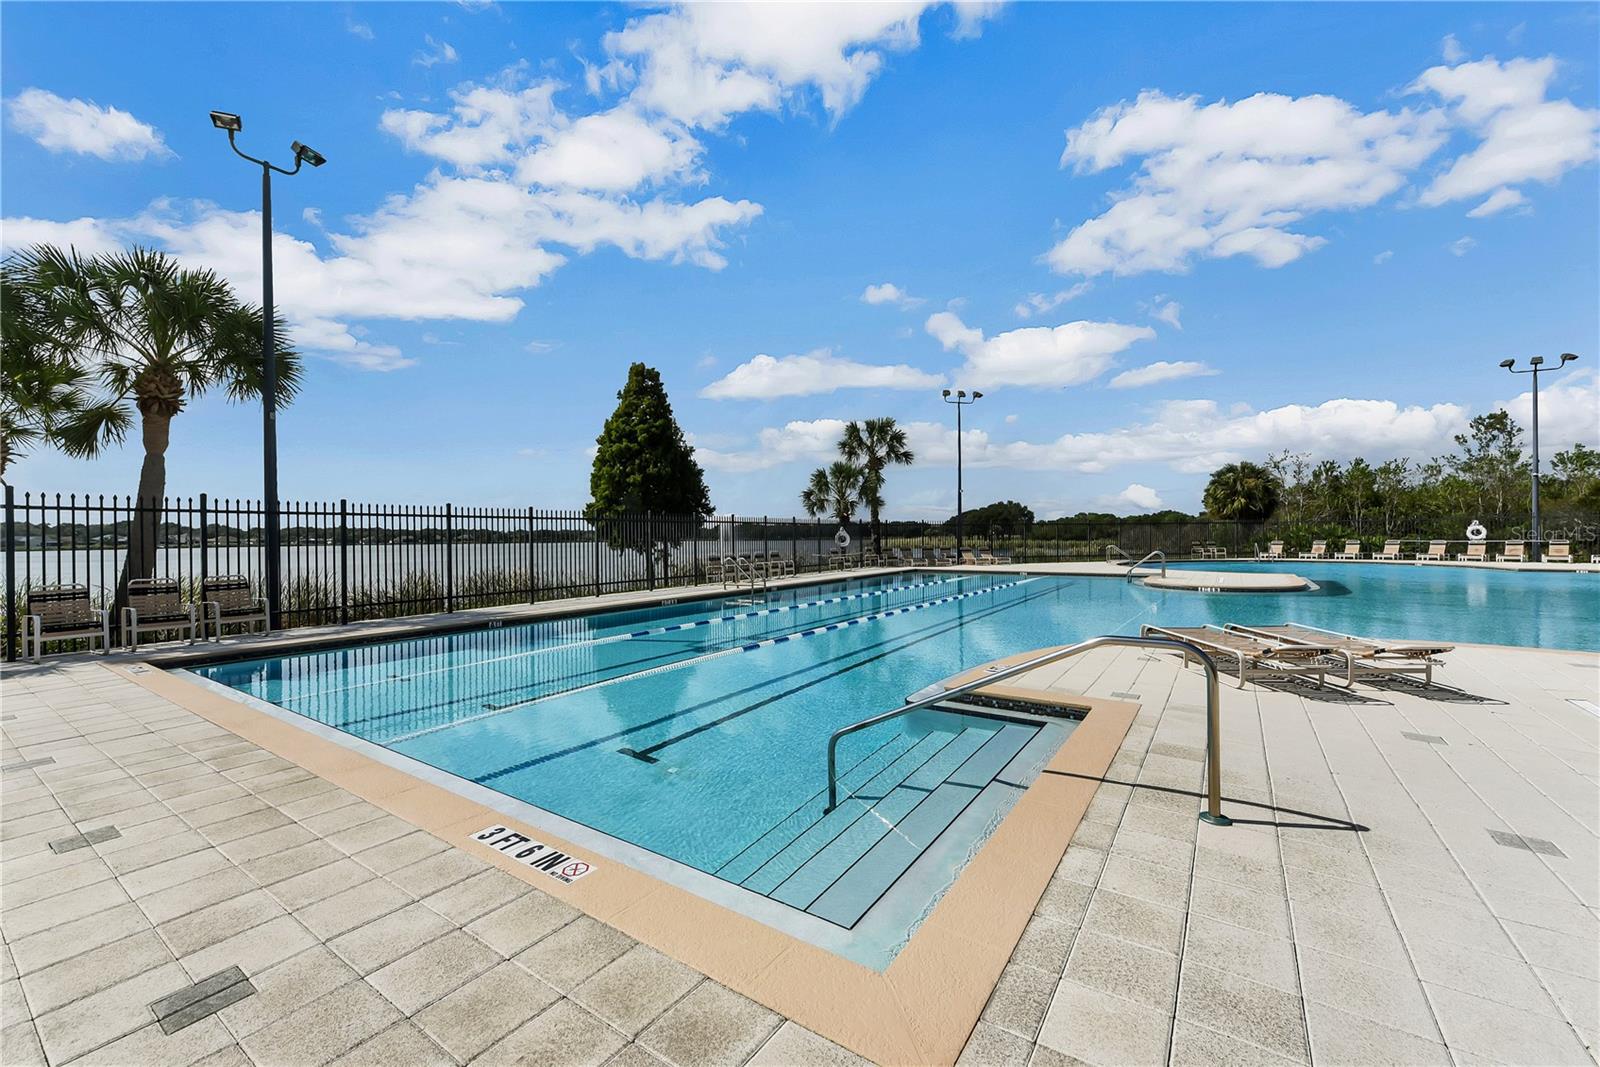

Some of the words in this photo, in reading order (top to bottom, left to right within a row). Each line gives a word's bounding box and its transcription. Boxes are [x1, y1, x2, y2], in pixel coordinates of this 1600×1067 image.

[477, 827, 506, 840] 3
[489, 833, 531, 851] FT
[515, 845, 545, 859] 6
[530, 851, 571, 872] IN
